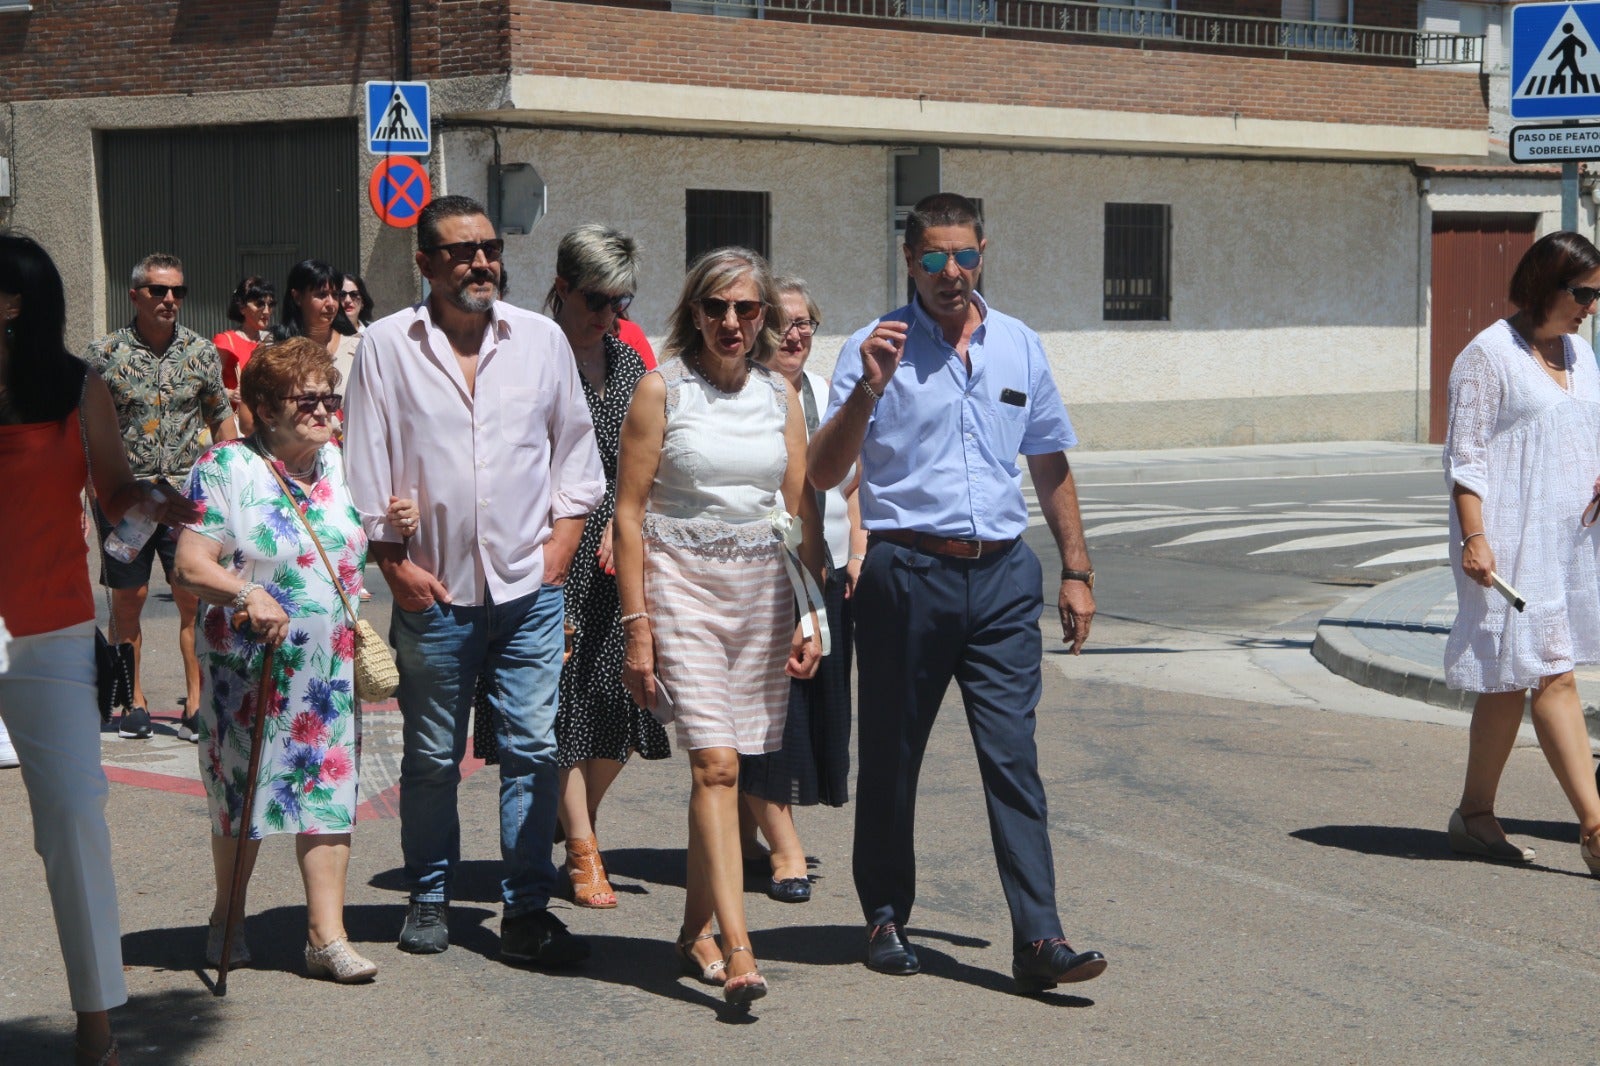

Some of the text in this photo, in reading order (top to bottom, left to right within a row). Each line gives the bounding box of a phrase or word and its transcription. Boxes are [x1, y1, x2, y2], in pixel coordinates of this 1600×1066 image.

[1518, 131, 1600, 142] PASO DE PEATO
[1529, 145, 1600, 155] SOBREELEVAD
